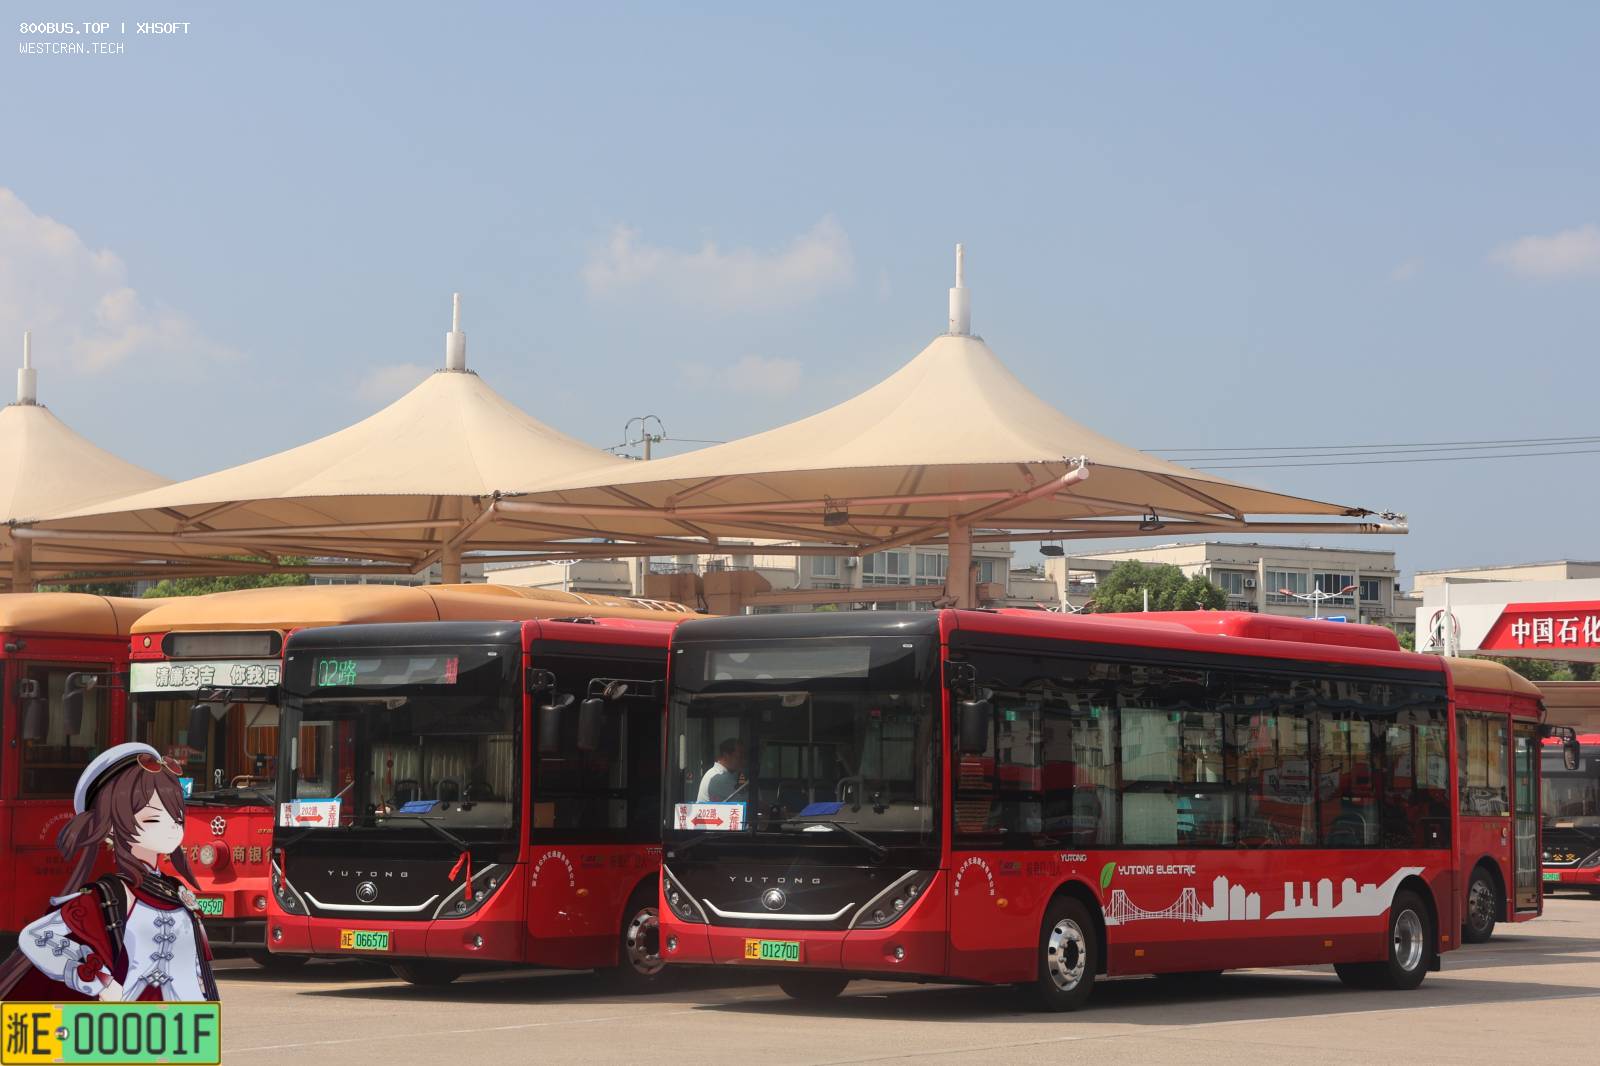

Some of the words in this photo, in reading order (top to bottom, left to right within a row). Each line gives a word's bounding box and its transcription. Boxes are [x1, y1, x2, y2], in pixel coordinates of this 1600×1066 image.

[1511, 615, 1600, 645] 中国石化
[155, 665, 215, 687] 清廉安吉
[229, 664, 280, 686] 你我同
[697, 808, 717, 819] 202路
[1061, 853, 1087, 862] YUTONG
[328, 870, 408, 878] YUTONG
[1118, 864, 1154, 875] YUTONG
[729, 876, 820, 884] YUTONG
